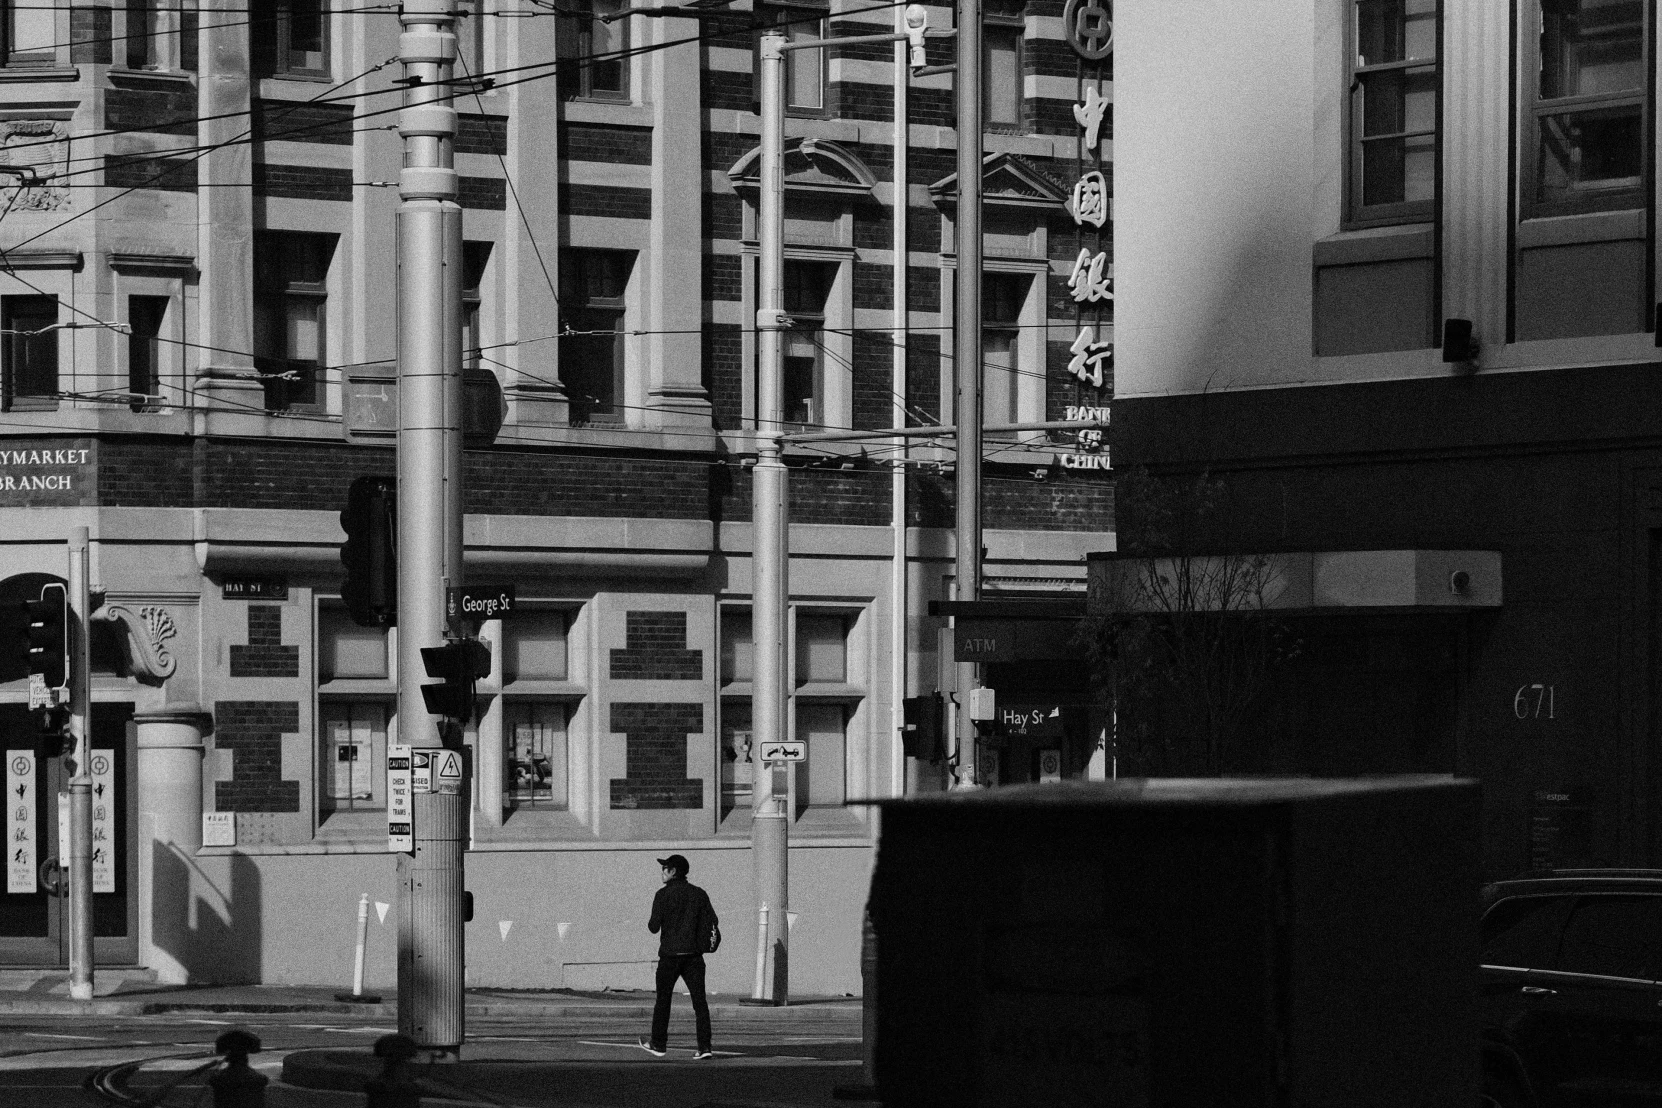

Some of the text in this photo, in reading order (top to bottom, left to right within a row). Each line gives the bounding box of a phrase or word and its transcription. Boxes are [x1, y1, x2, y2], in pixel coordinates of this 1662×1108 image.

[0, 450, 89, 465] YMARKET
[1060, 454, 1113, 470] CHIN
[462, 593, 510, 616] George St
[964, 638, 996, 652] ATM
[1514, 684, 1555, 719] 671
[1003, 709, 1045, 728] Hay St
[390, 758, 409, 768] CAUTION
[390, 825, 410, 833] CAUTION
